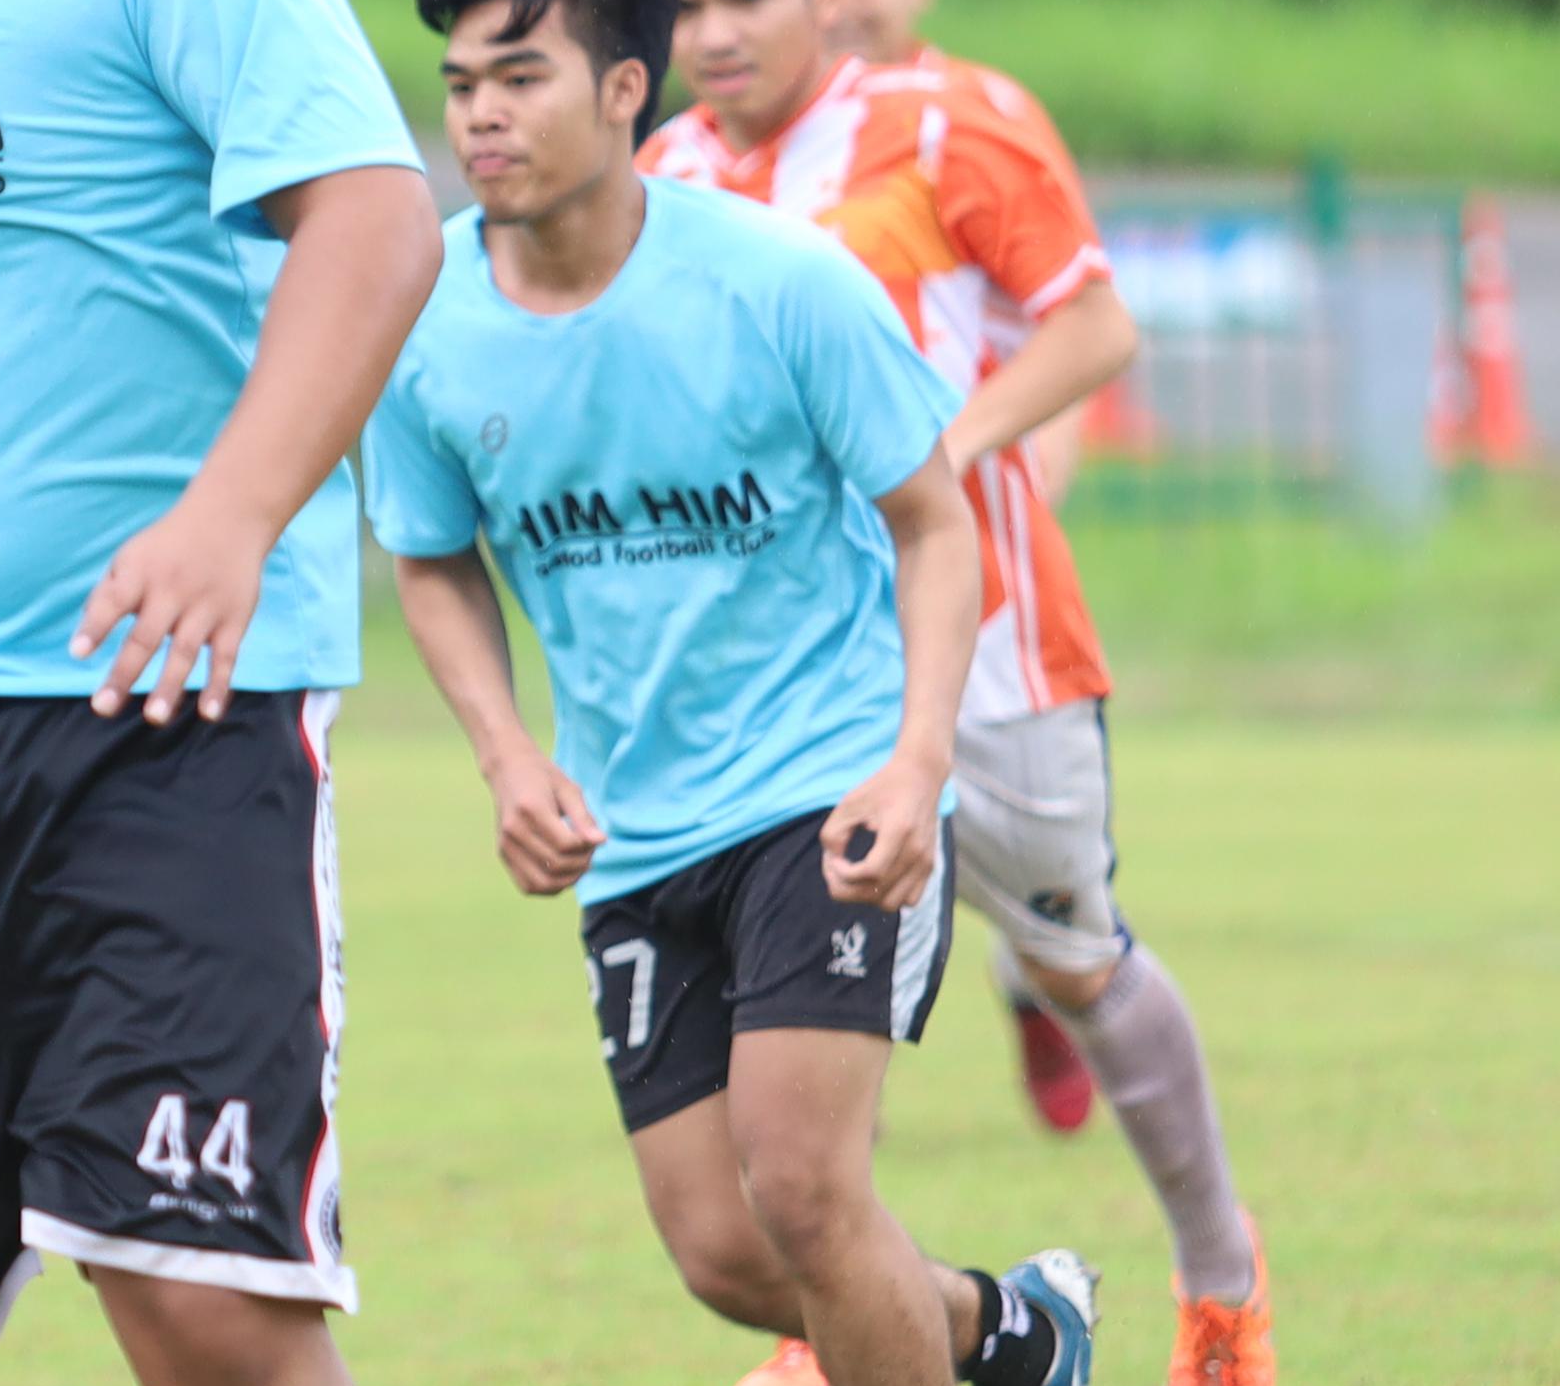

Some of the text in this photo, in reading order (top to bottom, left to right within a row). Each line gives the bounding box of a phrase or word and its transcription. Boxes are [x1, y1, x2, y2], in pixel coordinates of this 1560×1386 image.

[637, 469, 772, 529] HIM
[725, 524, 775, 557] Club
[136, 1093, 255, 1196] 44
